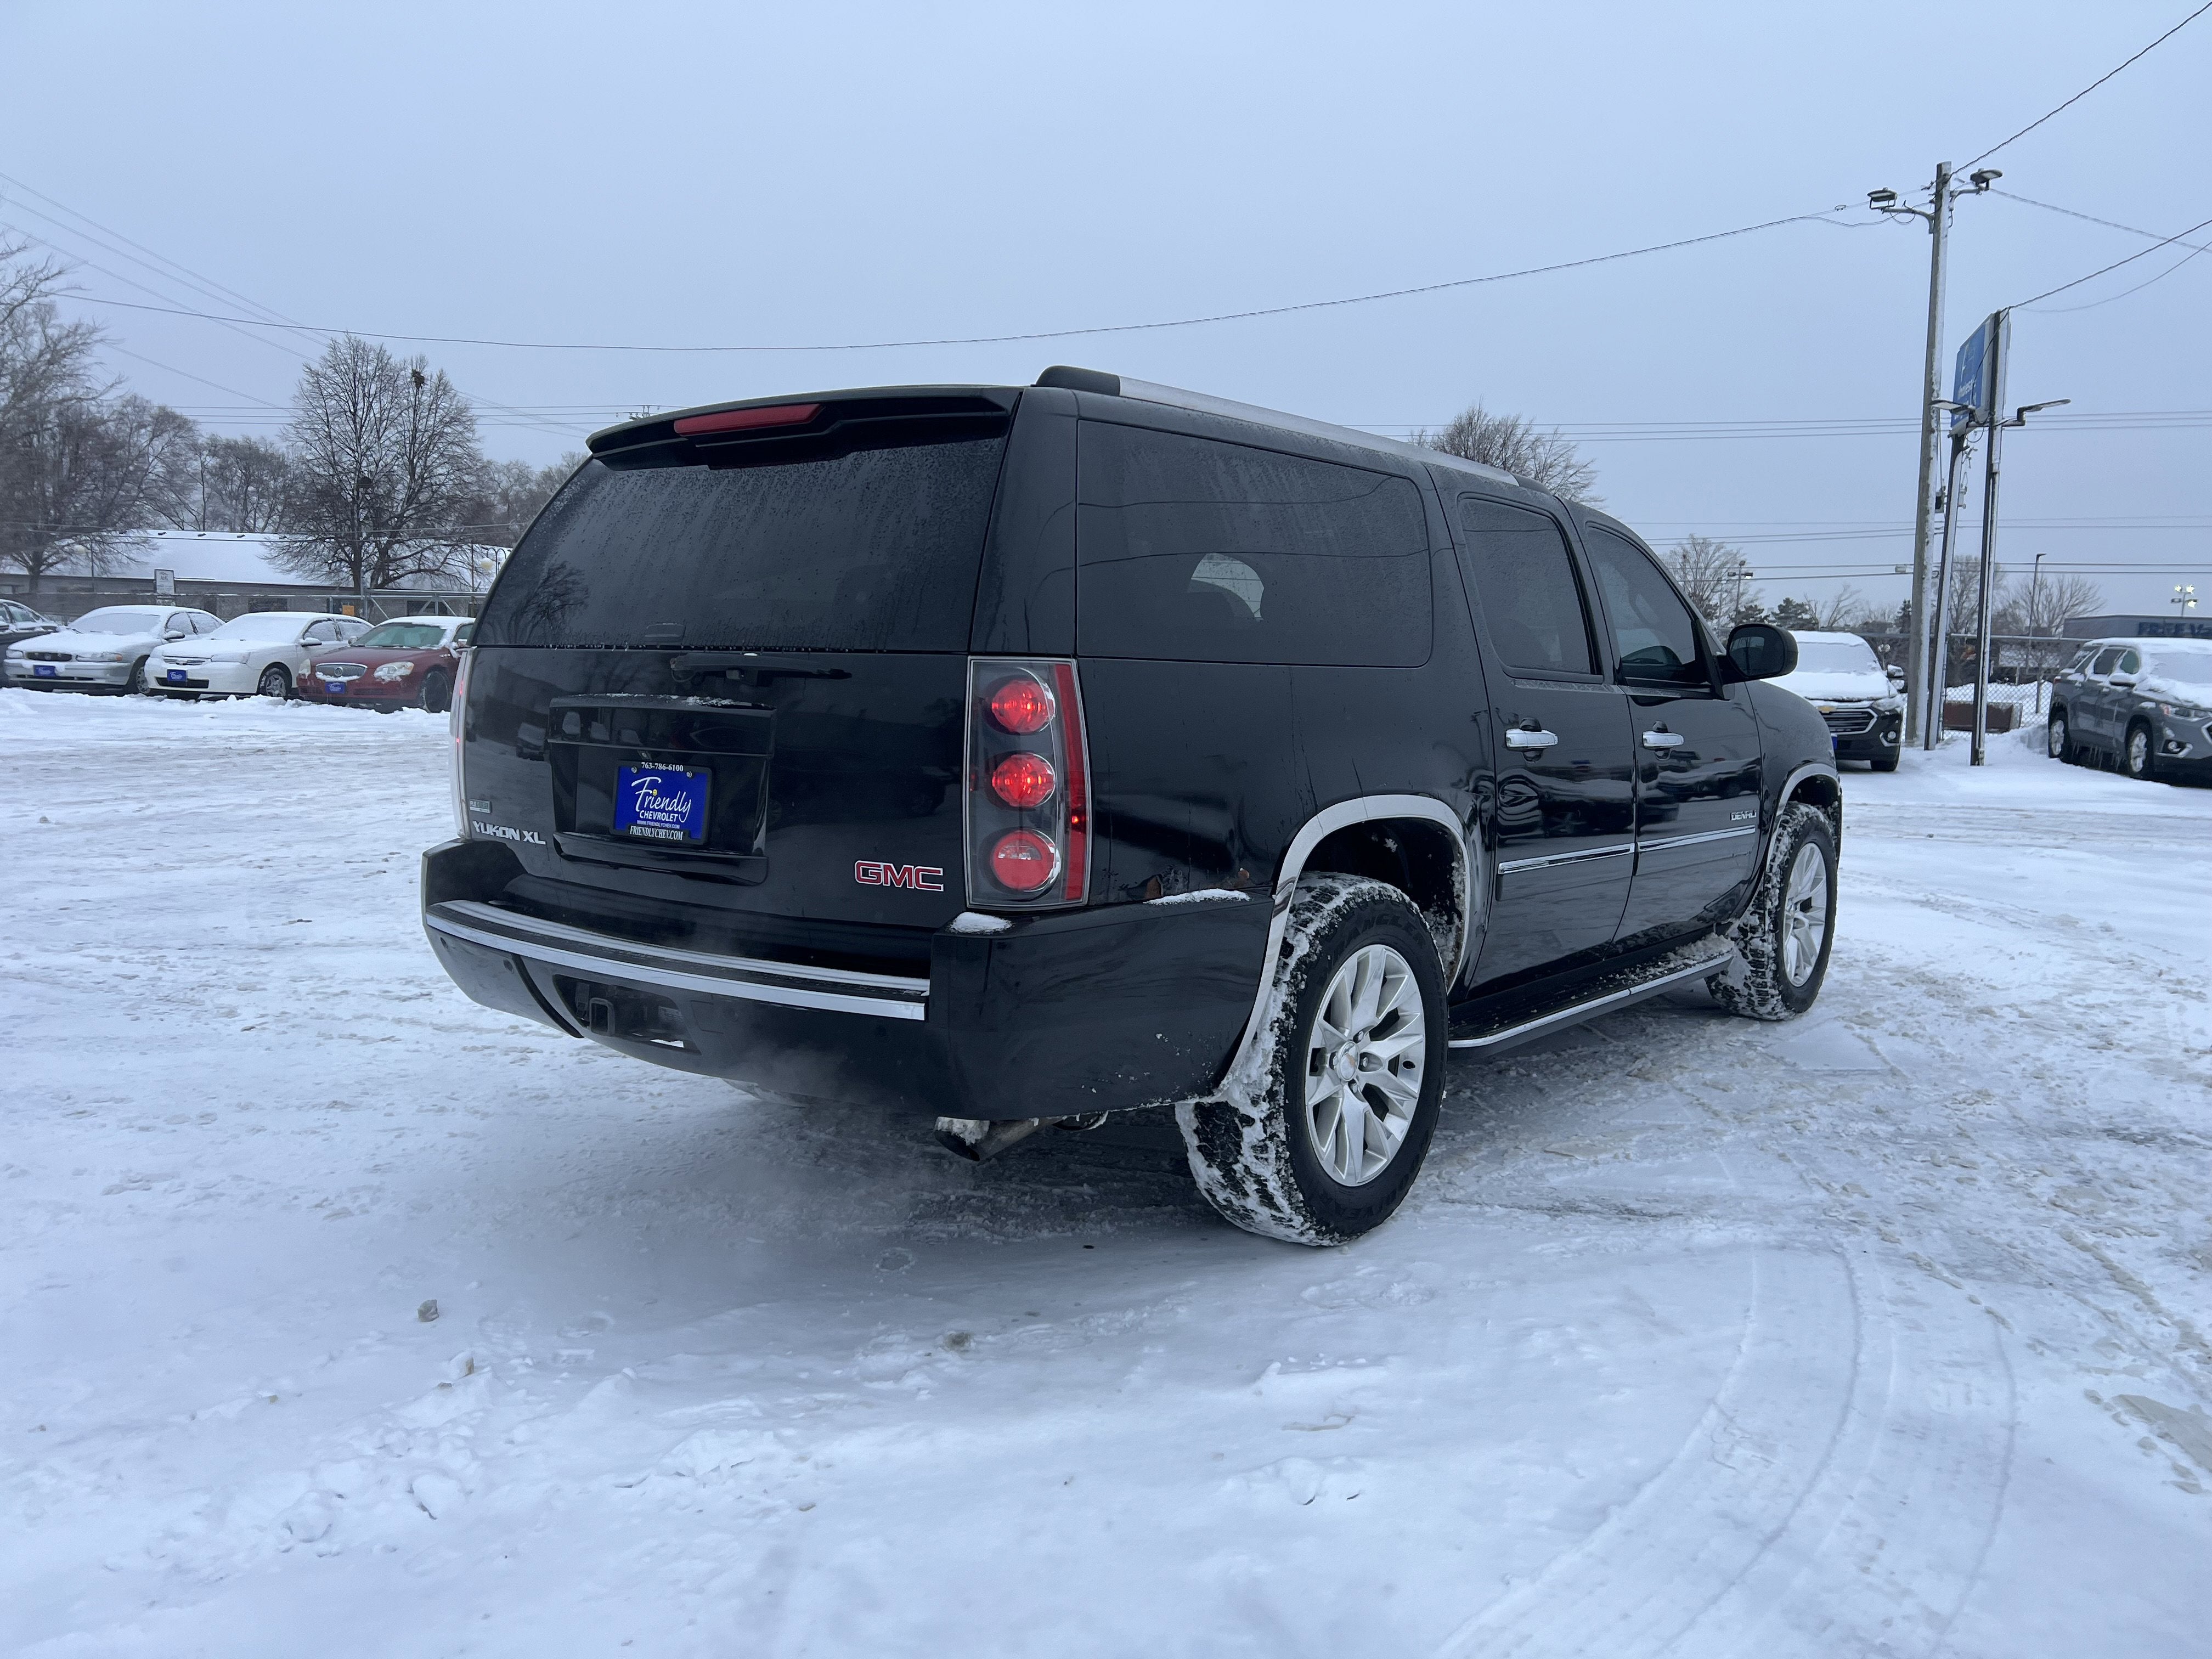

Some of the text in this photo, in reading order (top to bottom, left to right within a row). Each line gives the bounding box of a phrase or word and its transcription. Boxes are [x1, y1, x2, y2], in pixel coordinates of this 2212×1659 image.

[641, 761, 684, 772] 763-786-6100
[631, 776, 692, 823] Friendly
[640, 810, 678, 822] CHEVROLET
[472, 820, 546, 845] YUKON XL
[630, 826, 683, 840] FRIENDLYCHEV.COM
[854, 860, 944, 891] GMC
